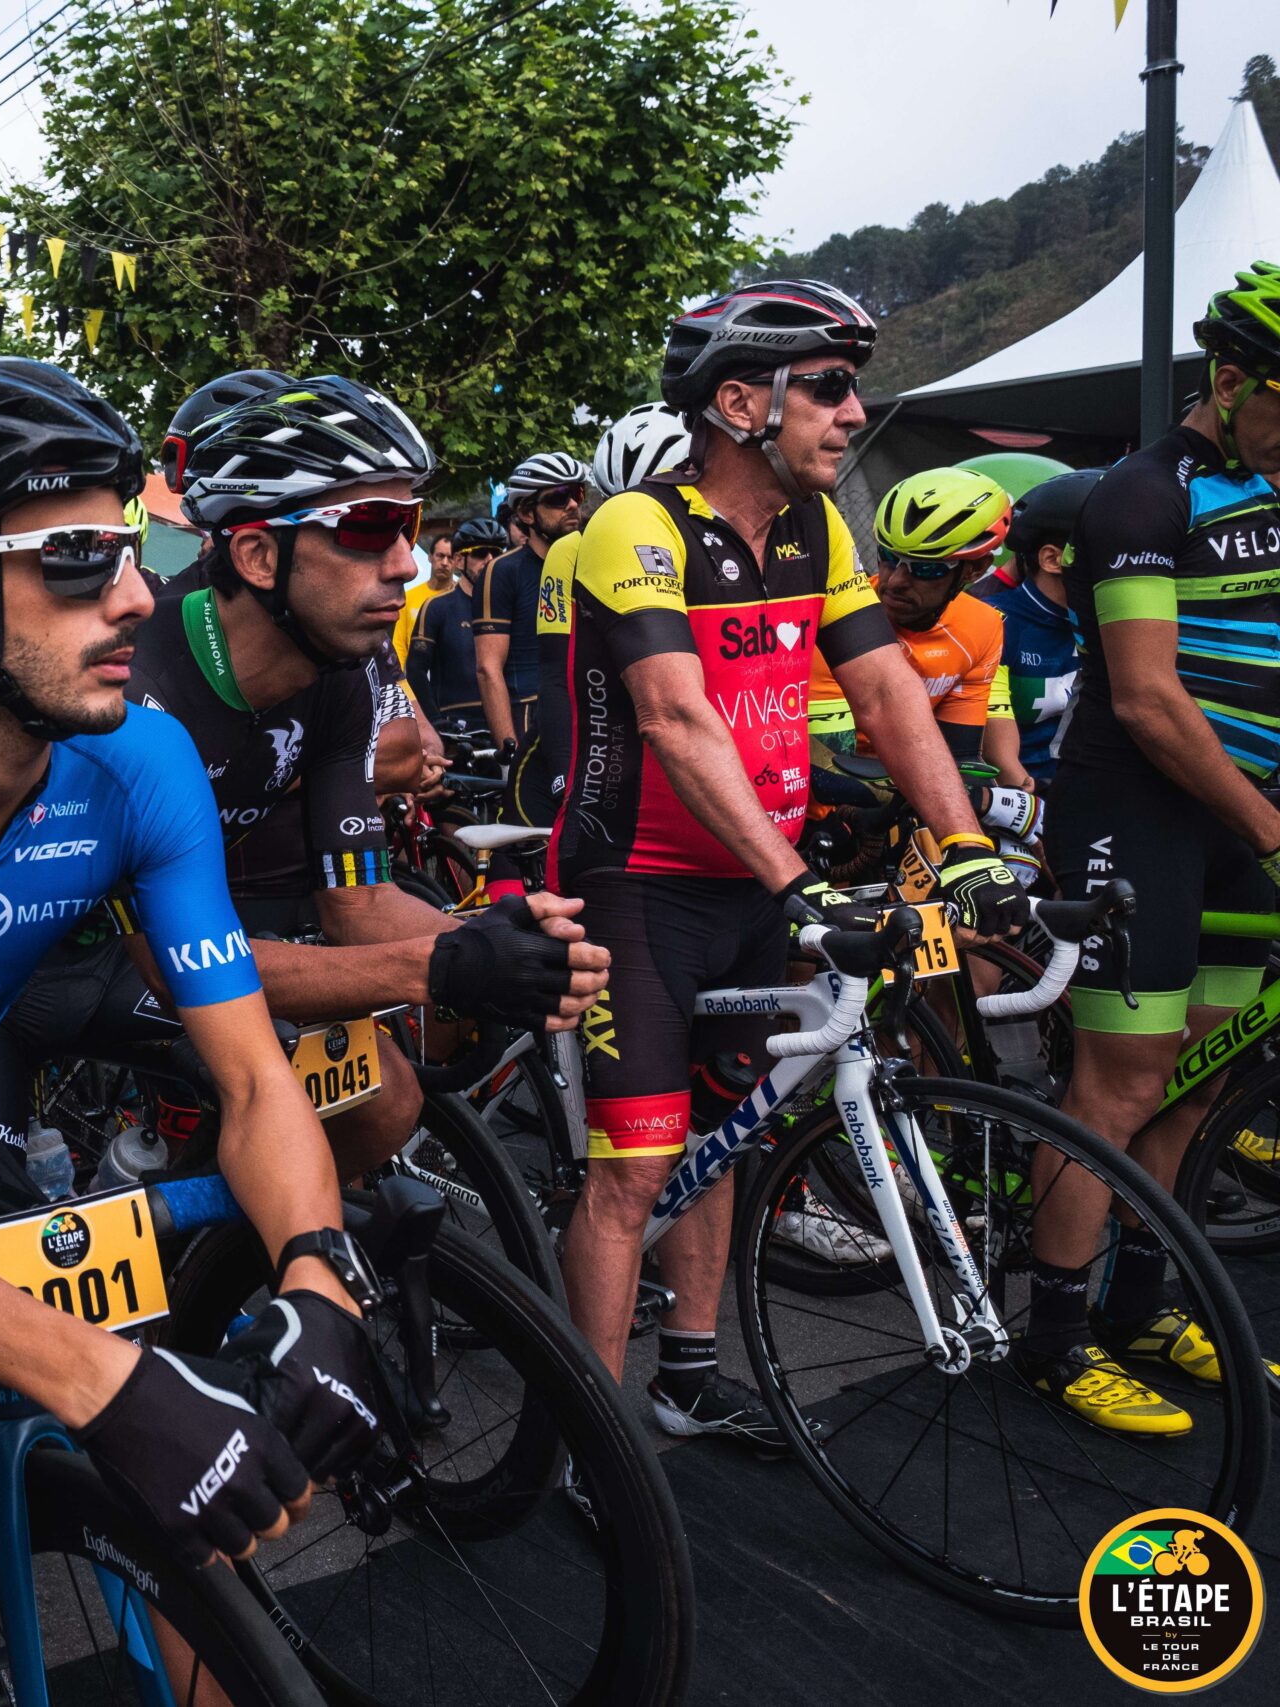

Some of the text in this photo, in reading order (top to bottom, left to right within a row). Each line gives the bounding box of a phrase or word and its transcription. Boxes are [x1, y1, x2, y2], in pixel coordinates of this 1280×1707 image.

[27, 475, 70, 493] KASK
[210, 483, 259, 491] cannondale
[1207, 527, 1280, 561] VÉLO
[556, 577, 567, 623] SPORT BIKE
[612, 576, 662, 593] PORTO
[203, 601, 226, 677] SUPERNOVA
[1020, 651, 1042, 667] BRD
[580, 668, 608, 806] VITOR HUGO
[602, 723, 625, 810] OSTEOPATA
[48, 798, 90, 818] Nalini
[1009, 791, 1027, 828] Tinkoff
[14, 839, 99, 863] VIGOR
[17, 898, 103, 925] MATTI
[167, 928, 252, 973] KASK
[913, 937, 949, 973] 15
[583, 988, 621, 1061] AX
[704, 993, 782, 1015] Rabobank
[304, 1053, 371, 1109] 0045
[625, 1112, 683, 1133] VIVACE
[651, 1076, 779, 1220] GIANT
[841, 1100, 883, 1190] Rabobank
[418, 1171, 480, 1206] SHIMANO
[16, 1257, 140, 1326] 001
[311, 1365, 378, 1431] VIGOR
[179, 1427, 251, 1517] VIGOR
[81, 1525, 161, 1600] Lightweight
